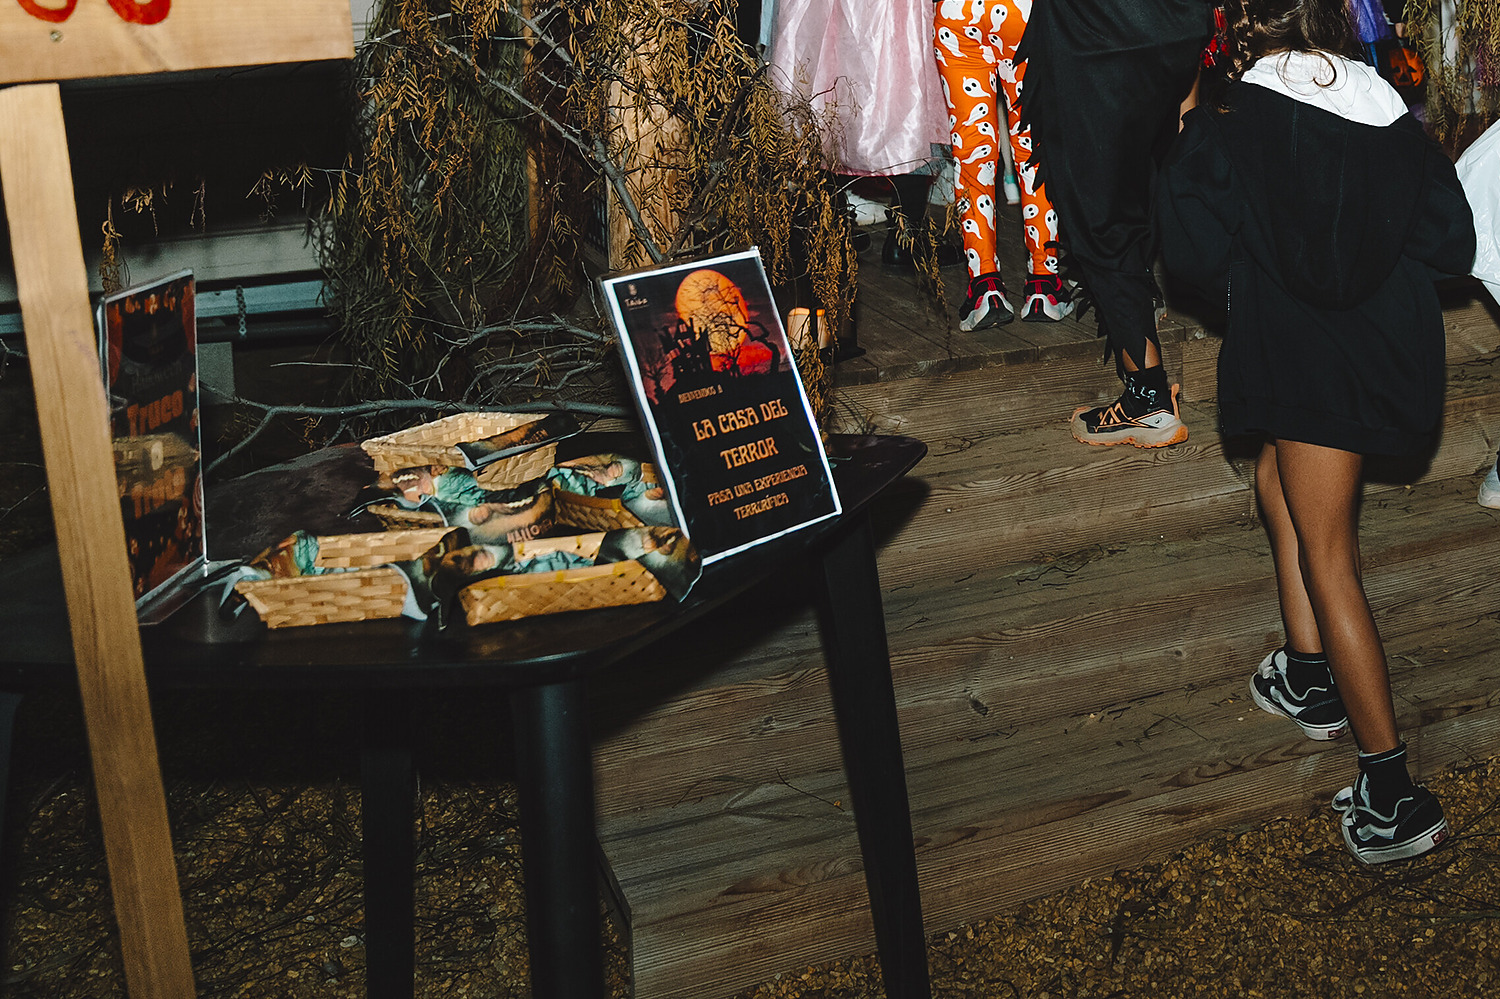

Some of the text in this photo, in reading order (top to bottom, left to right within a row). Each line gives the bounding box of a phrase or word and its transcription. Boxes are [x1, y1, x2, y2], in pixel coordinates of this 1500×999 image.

[127, 389, 184, 437] Truco
[692, 399, 789, 441] LA CASA DEL
[720, 436, 779, 470] TERROR
[707, 464, 808, 506] PASA UNA EXPERIENCIA
